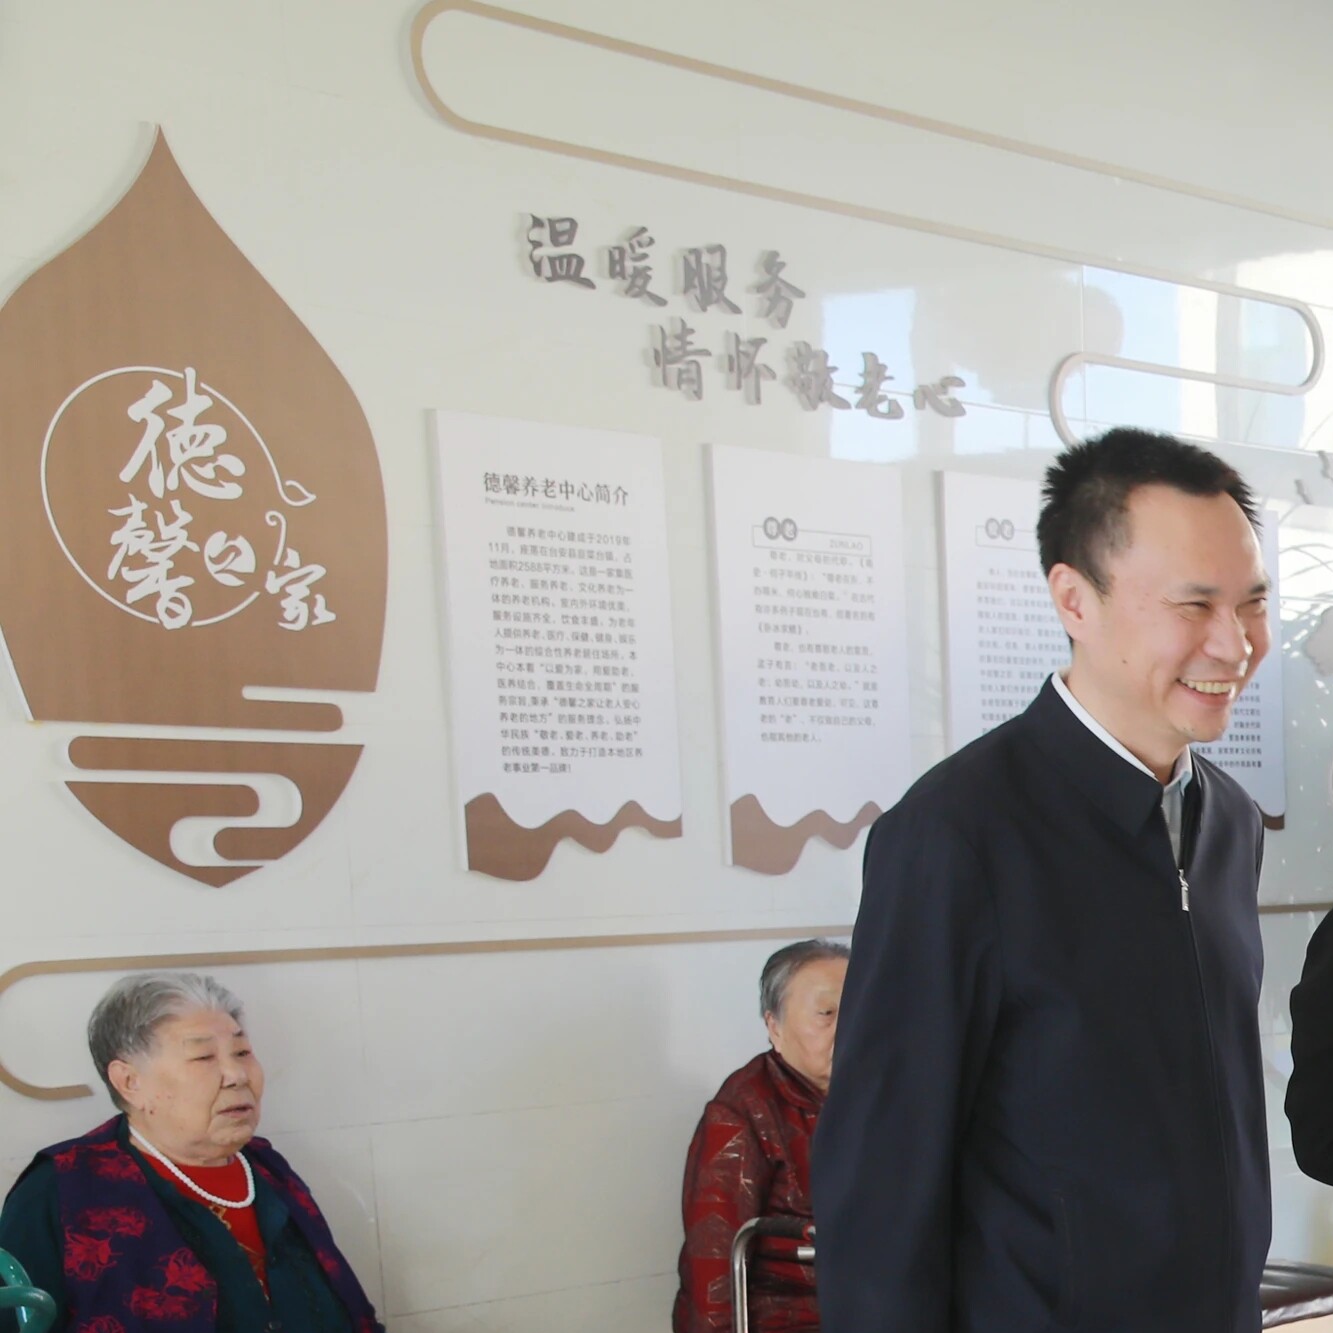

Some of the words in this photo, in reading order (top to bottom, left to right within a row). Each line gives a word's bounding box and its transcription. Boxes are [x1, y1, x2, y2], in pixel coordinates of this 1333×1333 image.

[526, 212, 806, 329] 温暖服务
[651, 316, 967, 420] 情怀敬老心
[483, 471, 630, 507] 德馨养老中心简介
